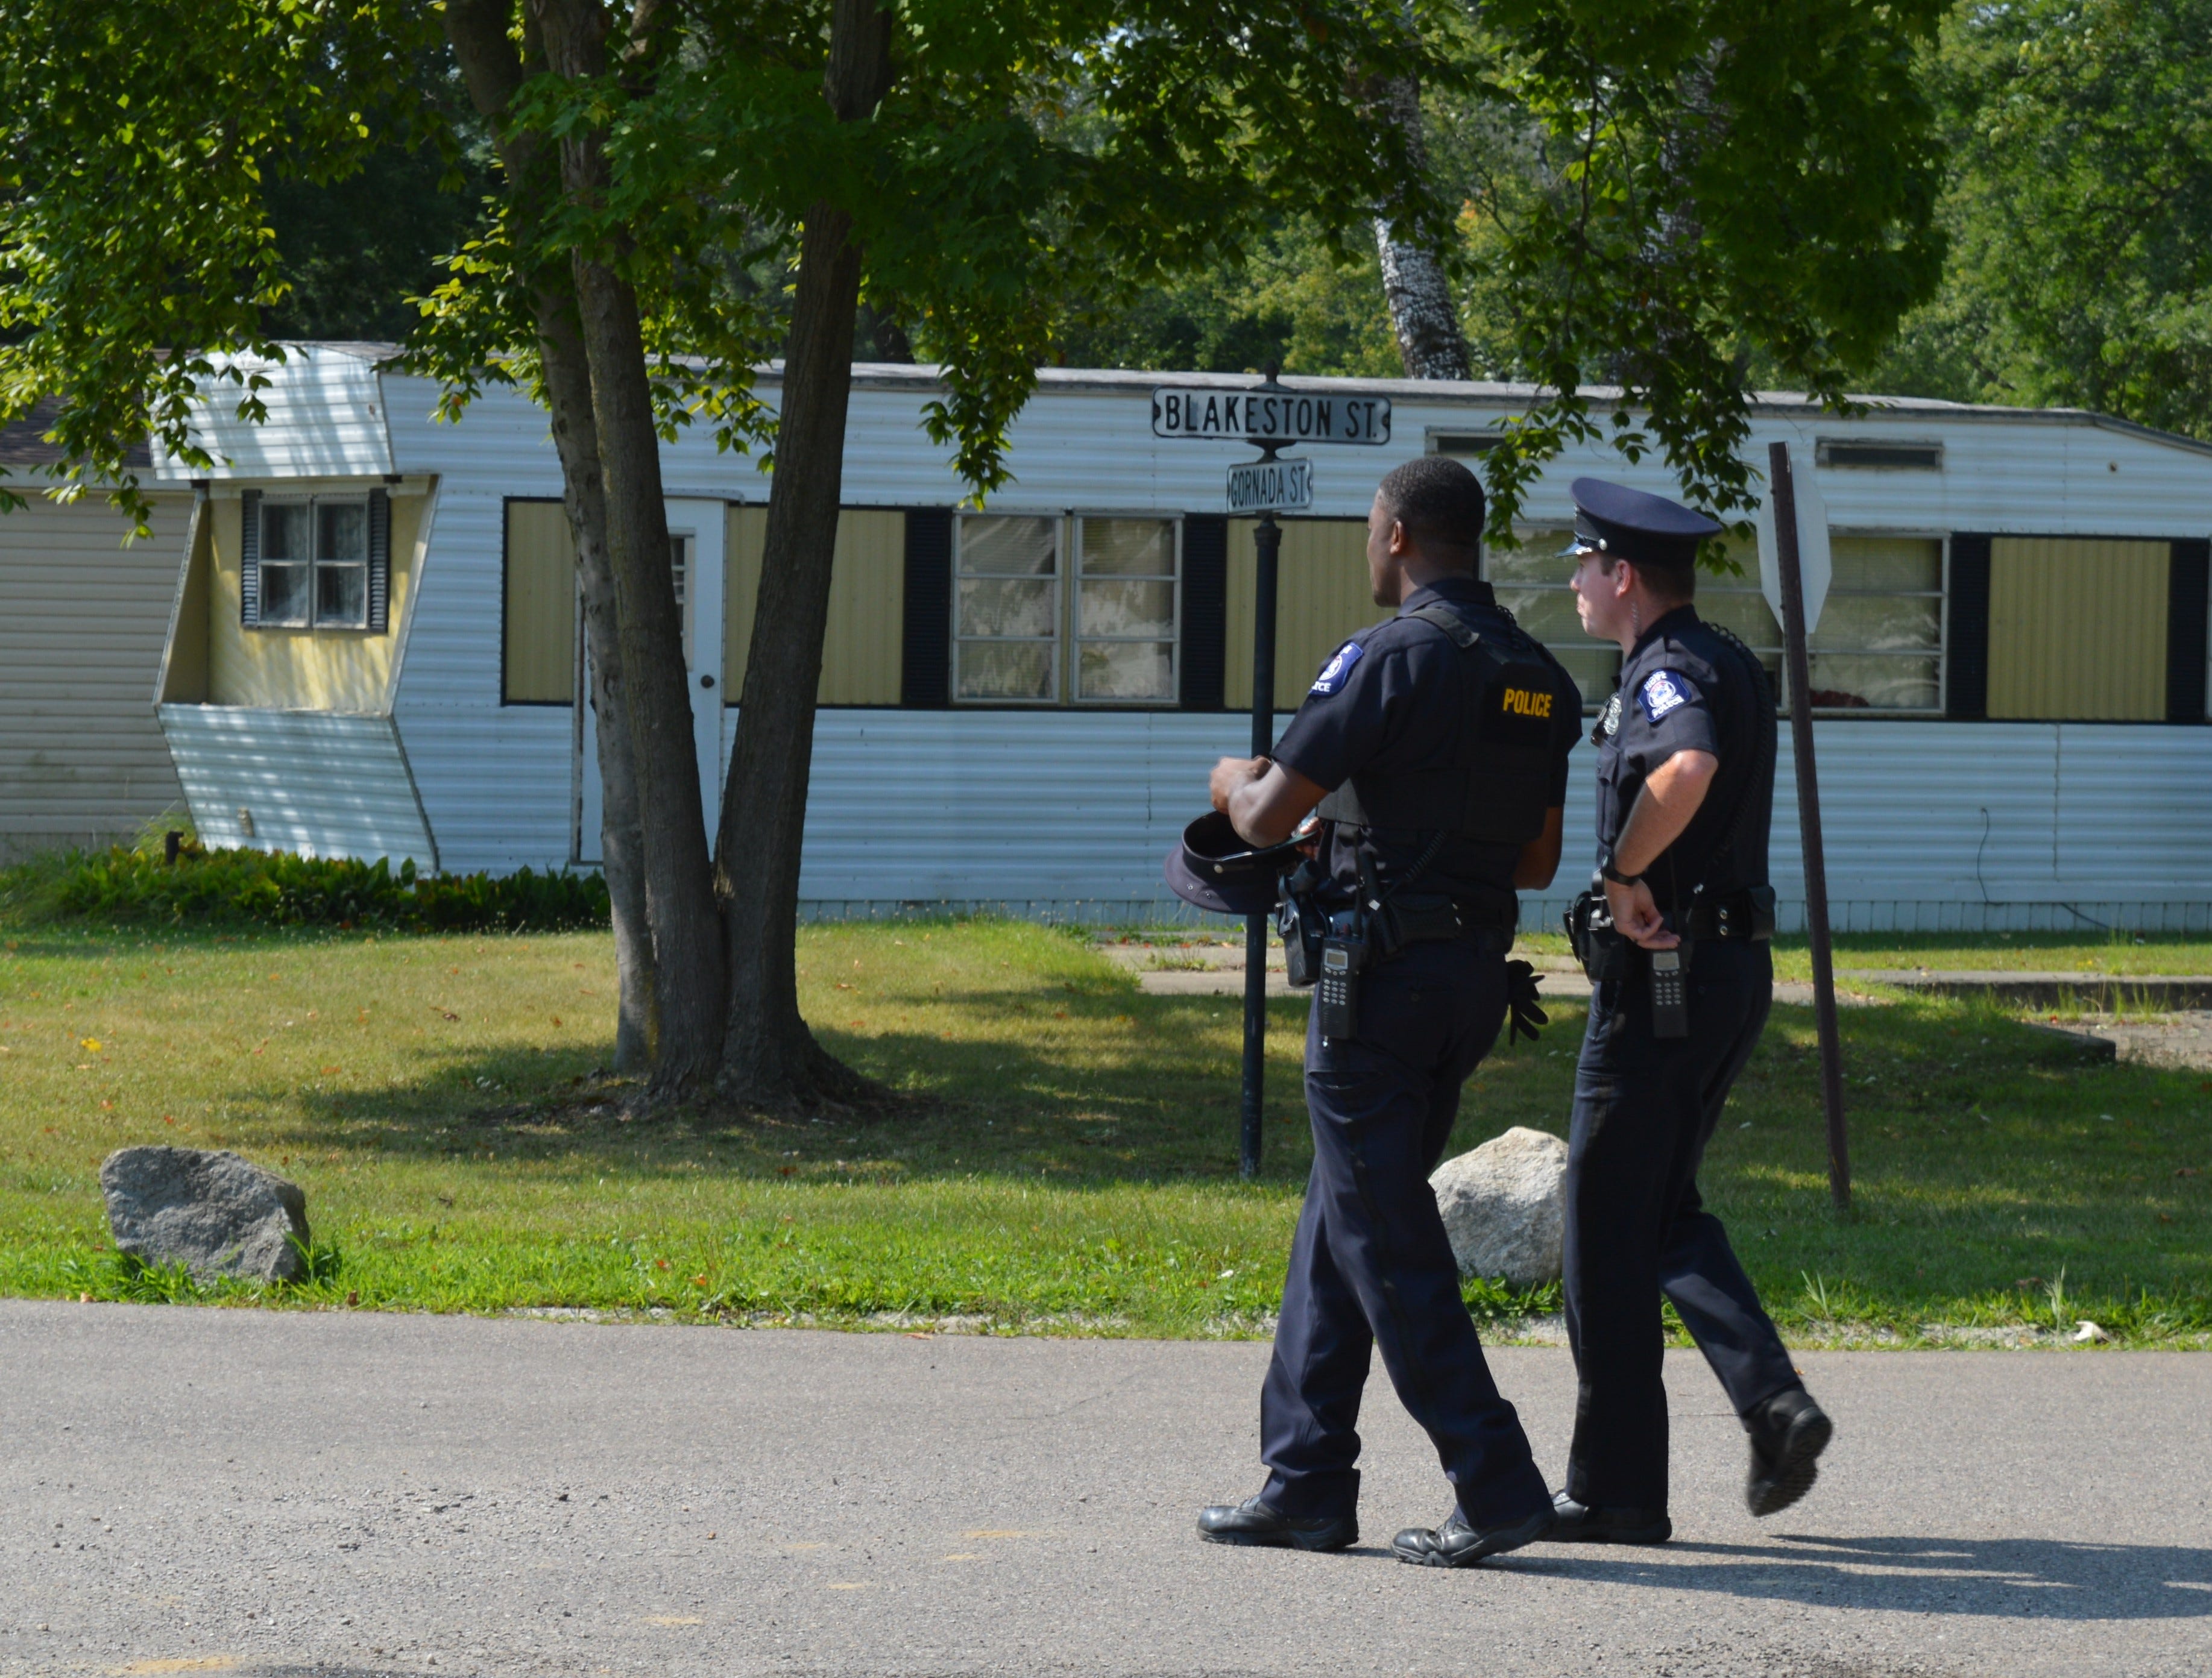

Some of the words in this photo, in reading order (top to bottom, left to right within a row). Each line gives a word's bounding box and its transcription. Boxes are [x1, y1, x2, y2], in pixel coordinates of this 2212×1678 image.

[1165, 394, 1331, 436] BLAKESTON
[1345, 401, 1377, 439] ST.
[1231, 467, 1285, 507] GORNADA
[1503, 688, 1553, 718] POLICE
[1651, 694, 1685, 718] POLICE
